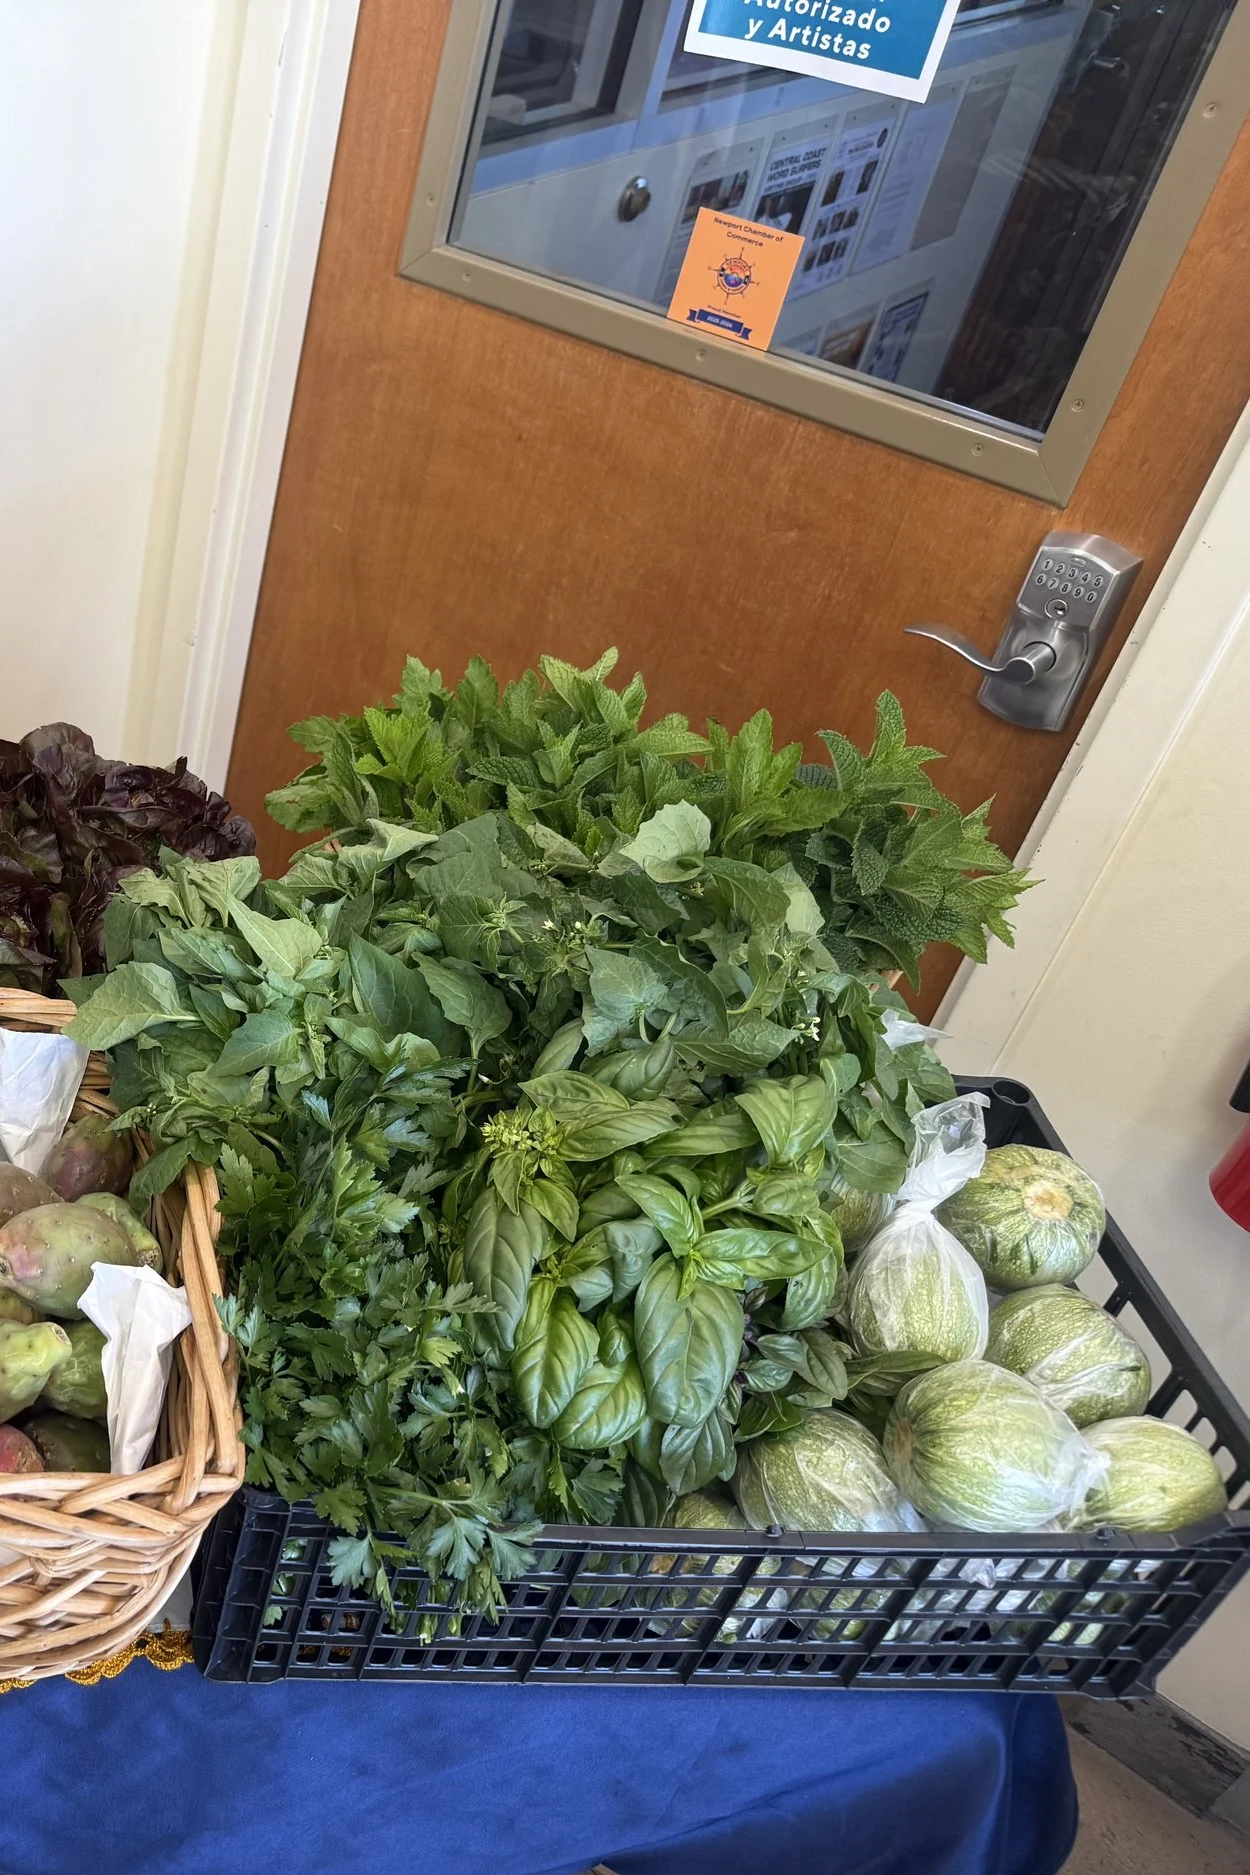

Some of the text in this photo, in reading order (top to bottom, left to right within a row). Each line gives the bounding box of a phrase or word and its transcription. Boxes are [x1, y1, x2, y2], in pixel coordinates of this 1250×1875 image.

[744, 18, 872, 60] y Artistas
[713, 217, 743, 231] Newport
[743, 225, 775, 240] Chamber
[726, 231, 764, 247] Commerce
[1036, 574, 1095, 602] 6 7 8 9 0
[1044, 560, 1102, 588] 1 2 3 4 5
